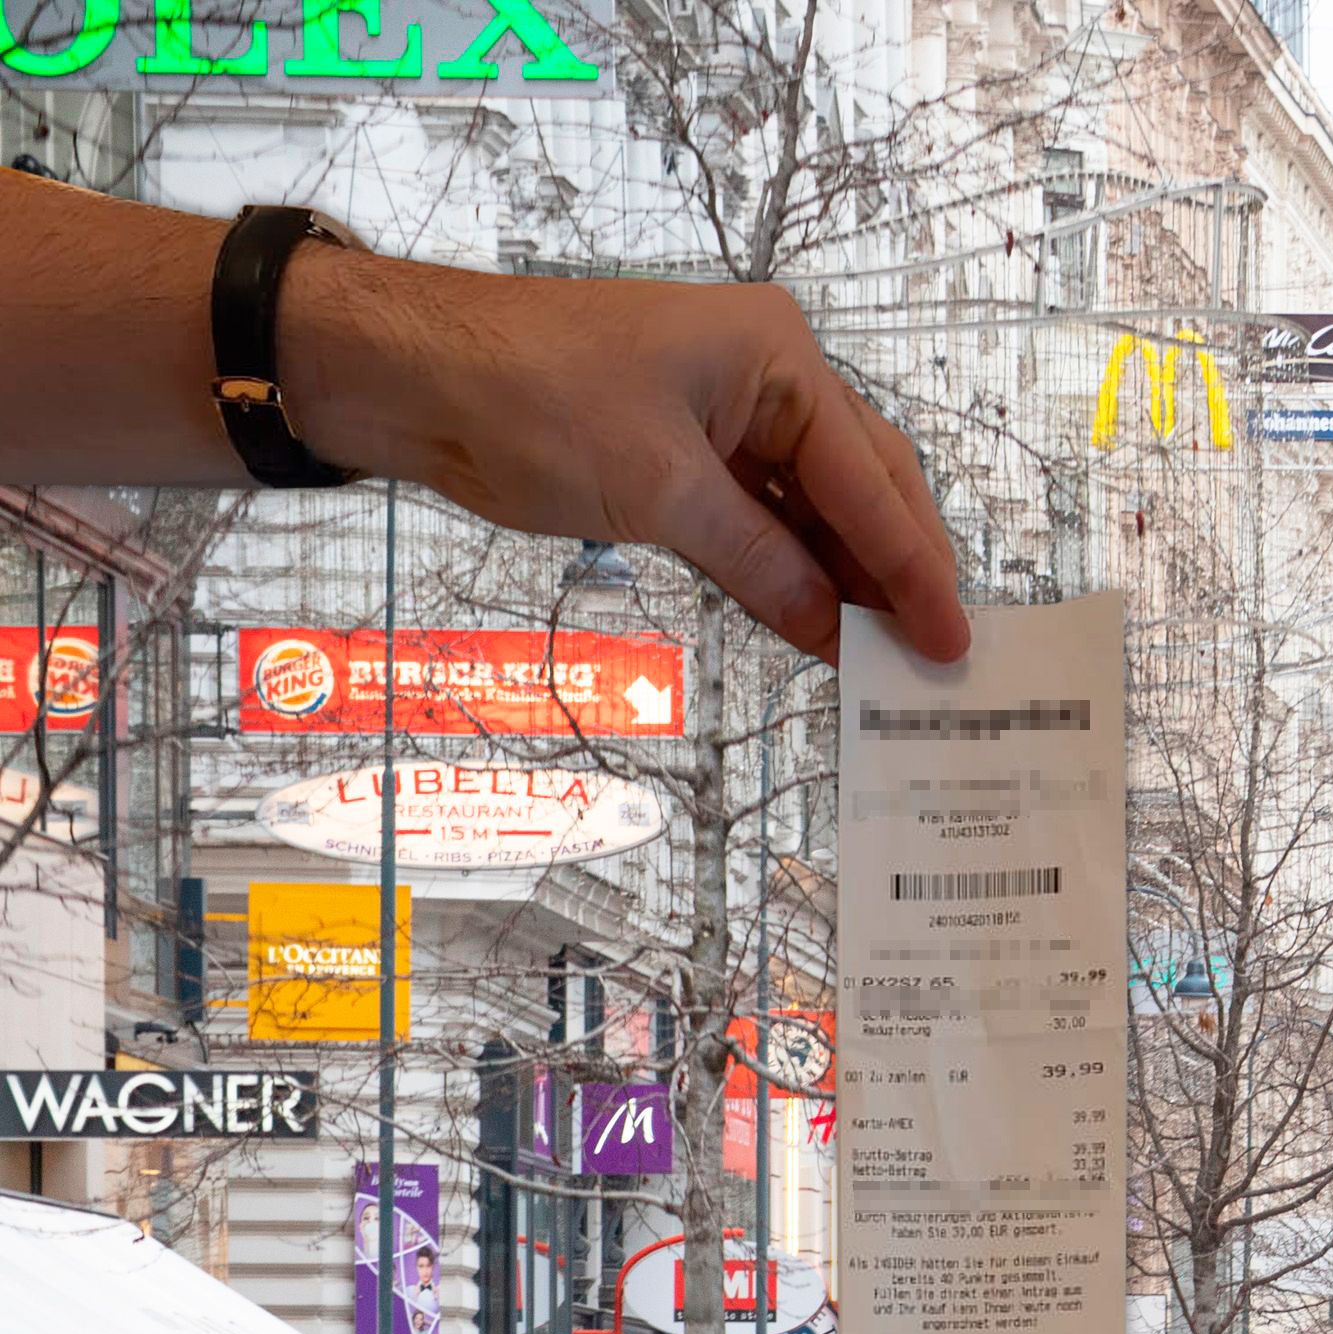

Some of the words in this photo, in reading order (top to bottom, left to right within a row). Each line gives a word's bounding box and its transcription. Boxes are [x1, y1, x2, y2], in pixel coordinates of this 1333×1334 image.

[262, 651, 322, 681] BURGER
[348, 660, 500, 687] BURGER
[503, 662, 596, 688] KING
[265, 669, 324, 700] KING
[337, 766, 590, 805] LUBELLA
[395, 804, 534, 819] RESTAURANT
[325, 838, 418, 862] SCHNIEL
[434, 850, 472, 863] RIBS
[488, 849, 534, 863] PIZZA
[268, 944, 381, 965] L'OCCITAN
[861, 1024, 931, 1038] Reduzierung
[888, 1070, 926, 1083] zahlen
[949, 1069, 969, 1083] EUR
[5, 1072, 306, 1134] WAGNER
[852, 1149, 933, 1162] Brutto-Betrag
[852, 1164, 927, 1178] Netto-Betrag
[928, 1225, 947, 1238] Sie
[990, 1225, 1008, 1238] EUR
[849, 1258, 868, 1270] Als
[965, 1256, 983, 1269] Sie
[1013, 1254, 1051, 1267] diesen
[1057, 1252, 1100, 1266] Einkauf
[891, 1273, 934, 1285] bereits
[959, 1271, 997, 1284] Punkte
[940, 1287, 977, 1299] direkt
[874, 1303, 893, 1315] und
[898, 1303, 915, 1315] Ihr
[922, 1302, 946, 1315] Kauf
[1056, 1299, 1082, 1311] noch
[922, 1317, 990, 1331] angerechnet
